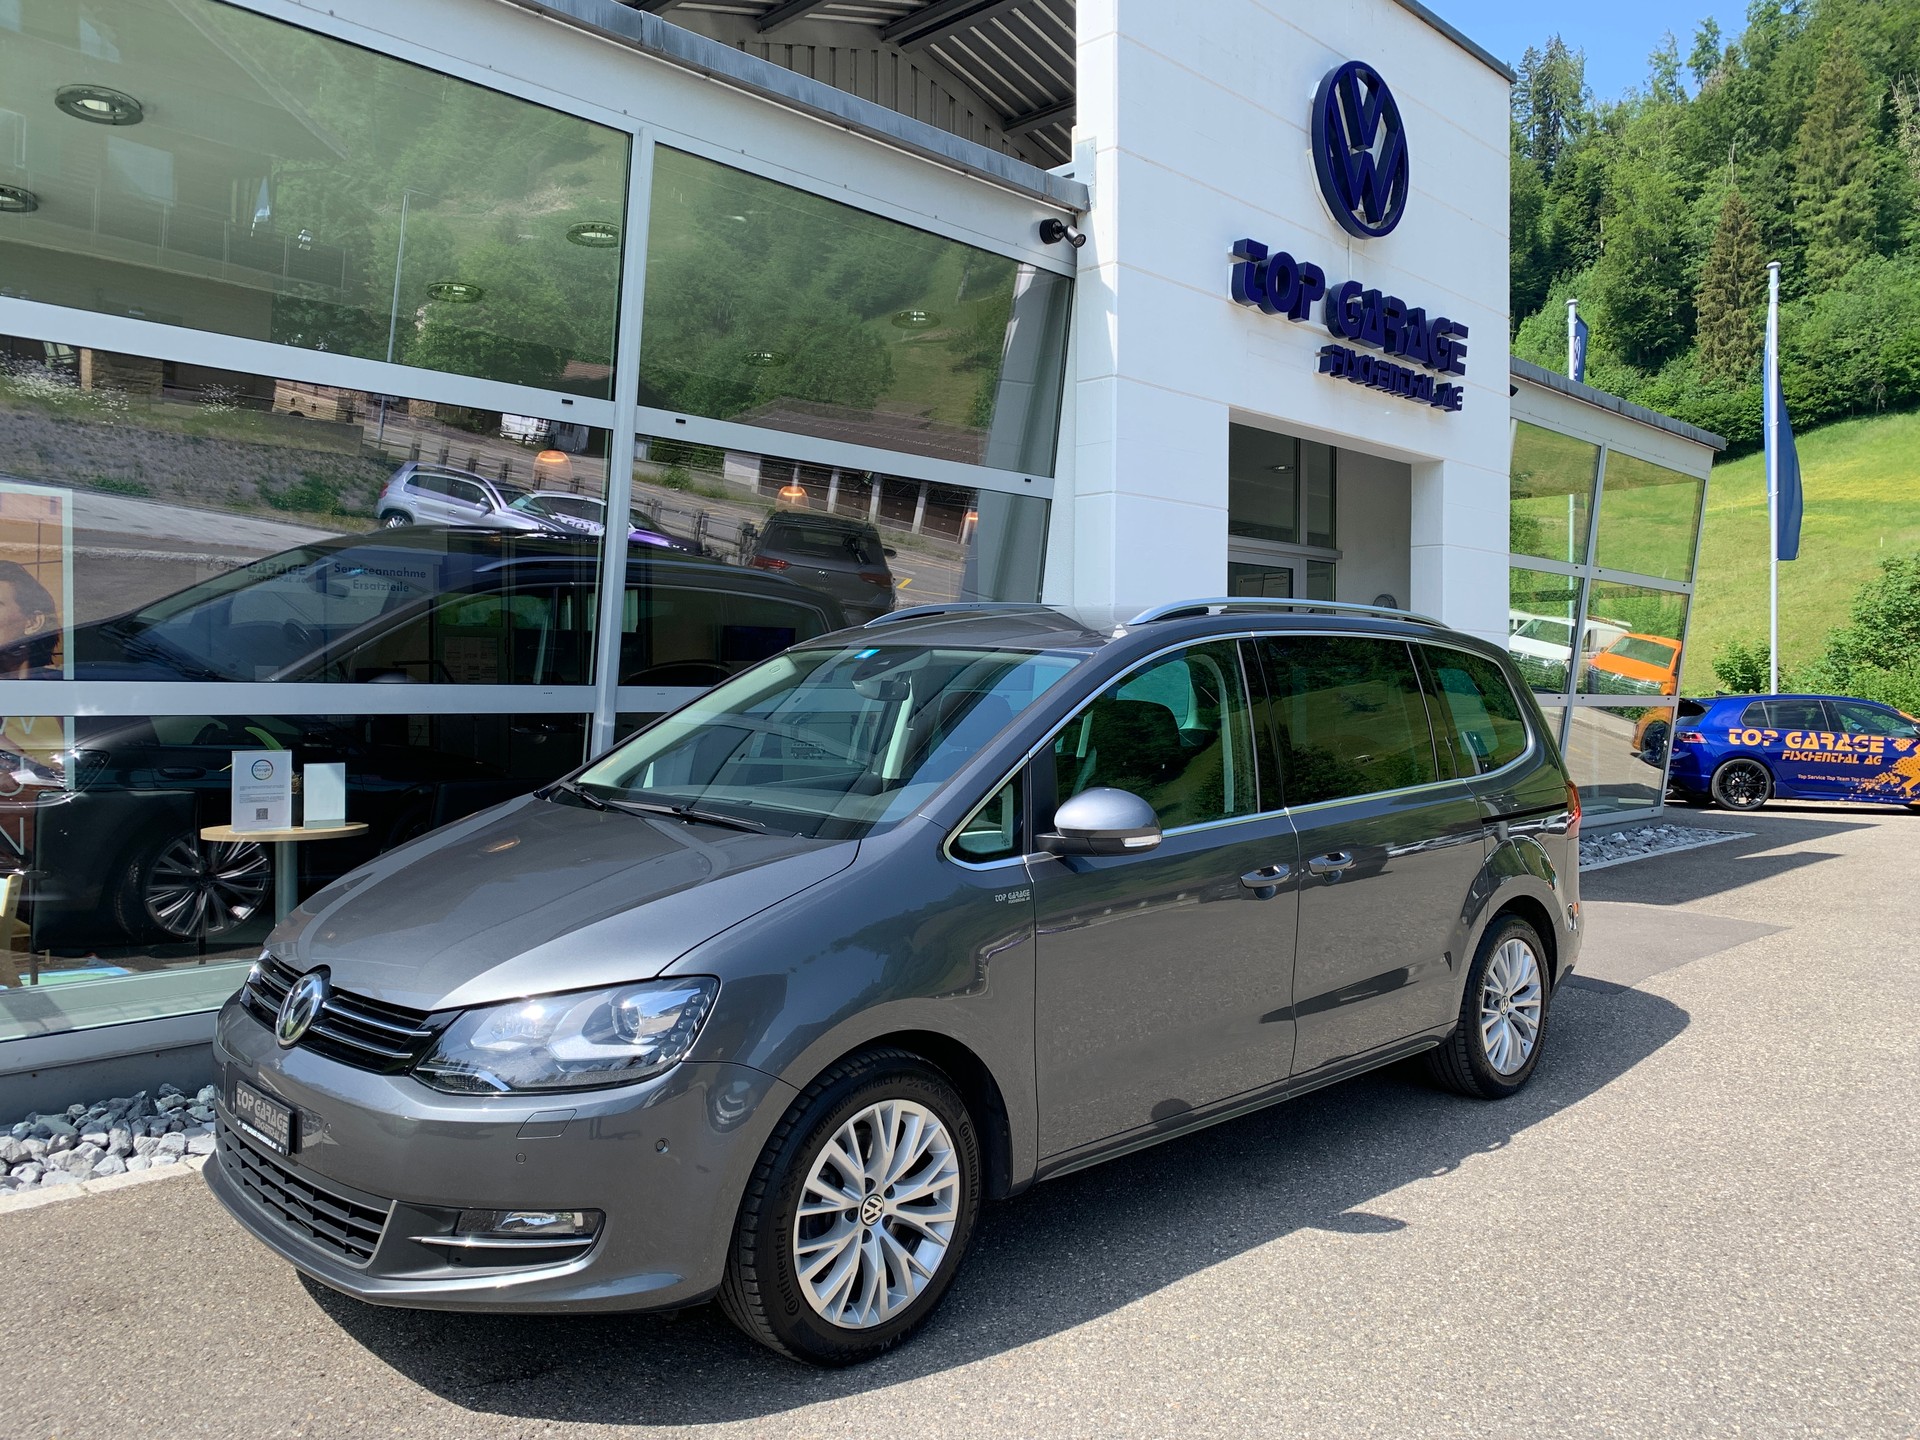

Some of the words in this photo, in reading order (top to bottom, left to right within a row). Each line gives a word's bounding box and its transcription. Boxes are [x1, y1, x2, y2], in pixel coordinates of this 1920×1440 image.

[1312, 60, 1409, 239] VW
[1232, 238, 1326, 322] TOP
[1325, 280, 1469, 377] GARAGE
[1319, 344, 1437, 405] FISCHENTHAL
[1431, 382, 1464, 413] AG
[353, 579, 410, 592] Ersatzteile
[1728, 728, 1779, 747] TOP
[1785, 731, 1885, 753] GARAGE
[1782, 750, 1860, 764] FISCHENTHAL
[1863, 755, 1883, 766] AG
[995, 893, 1007, 903] TOP
[1007, 889, 1030, 900] GARAGE
[237, 1087, 254, 1112] TOP
[254, 1099, 288, 1134] GARAGE
[774, 1227, 801, 1317] Continental
